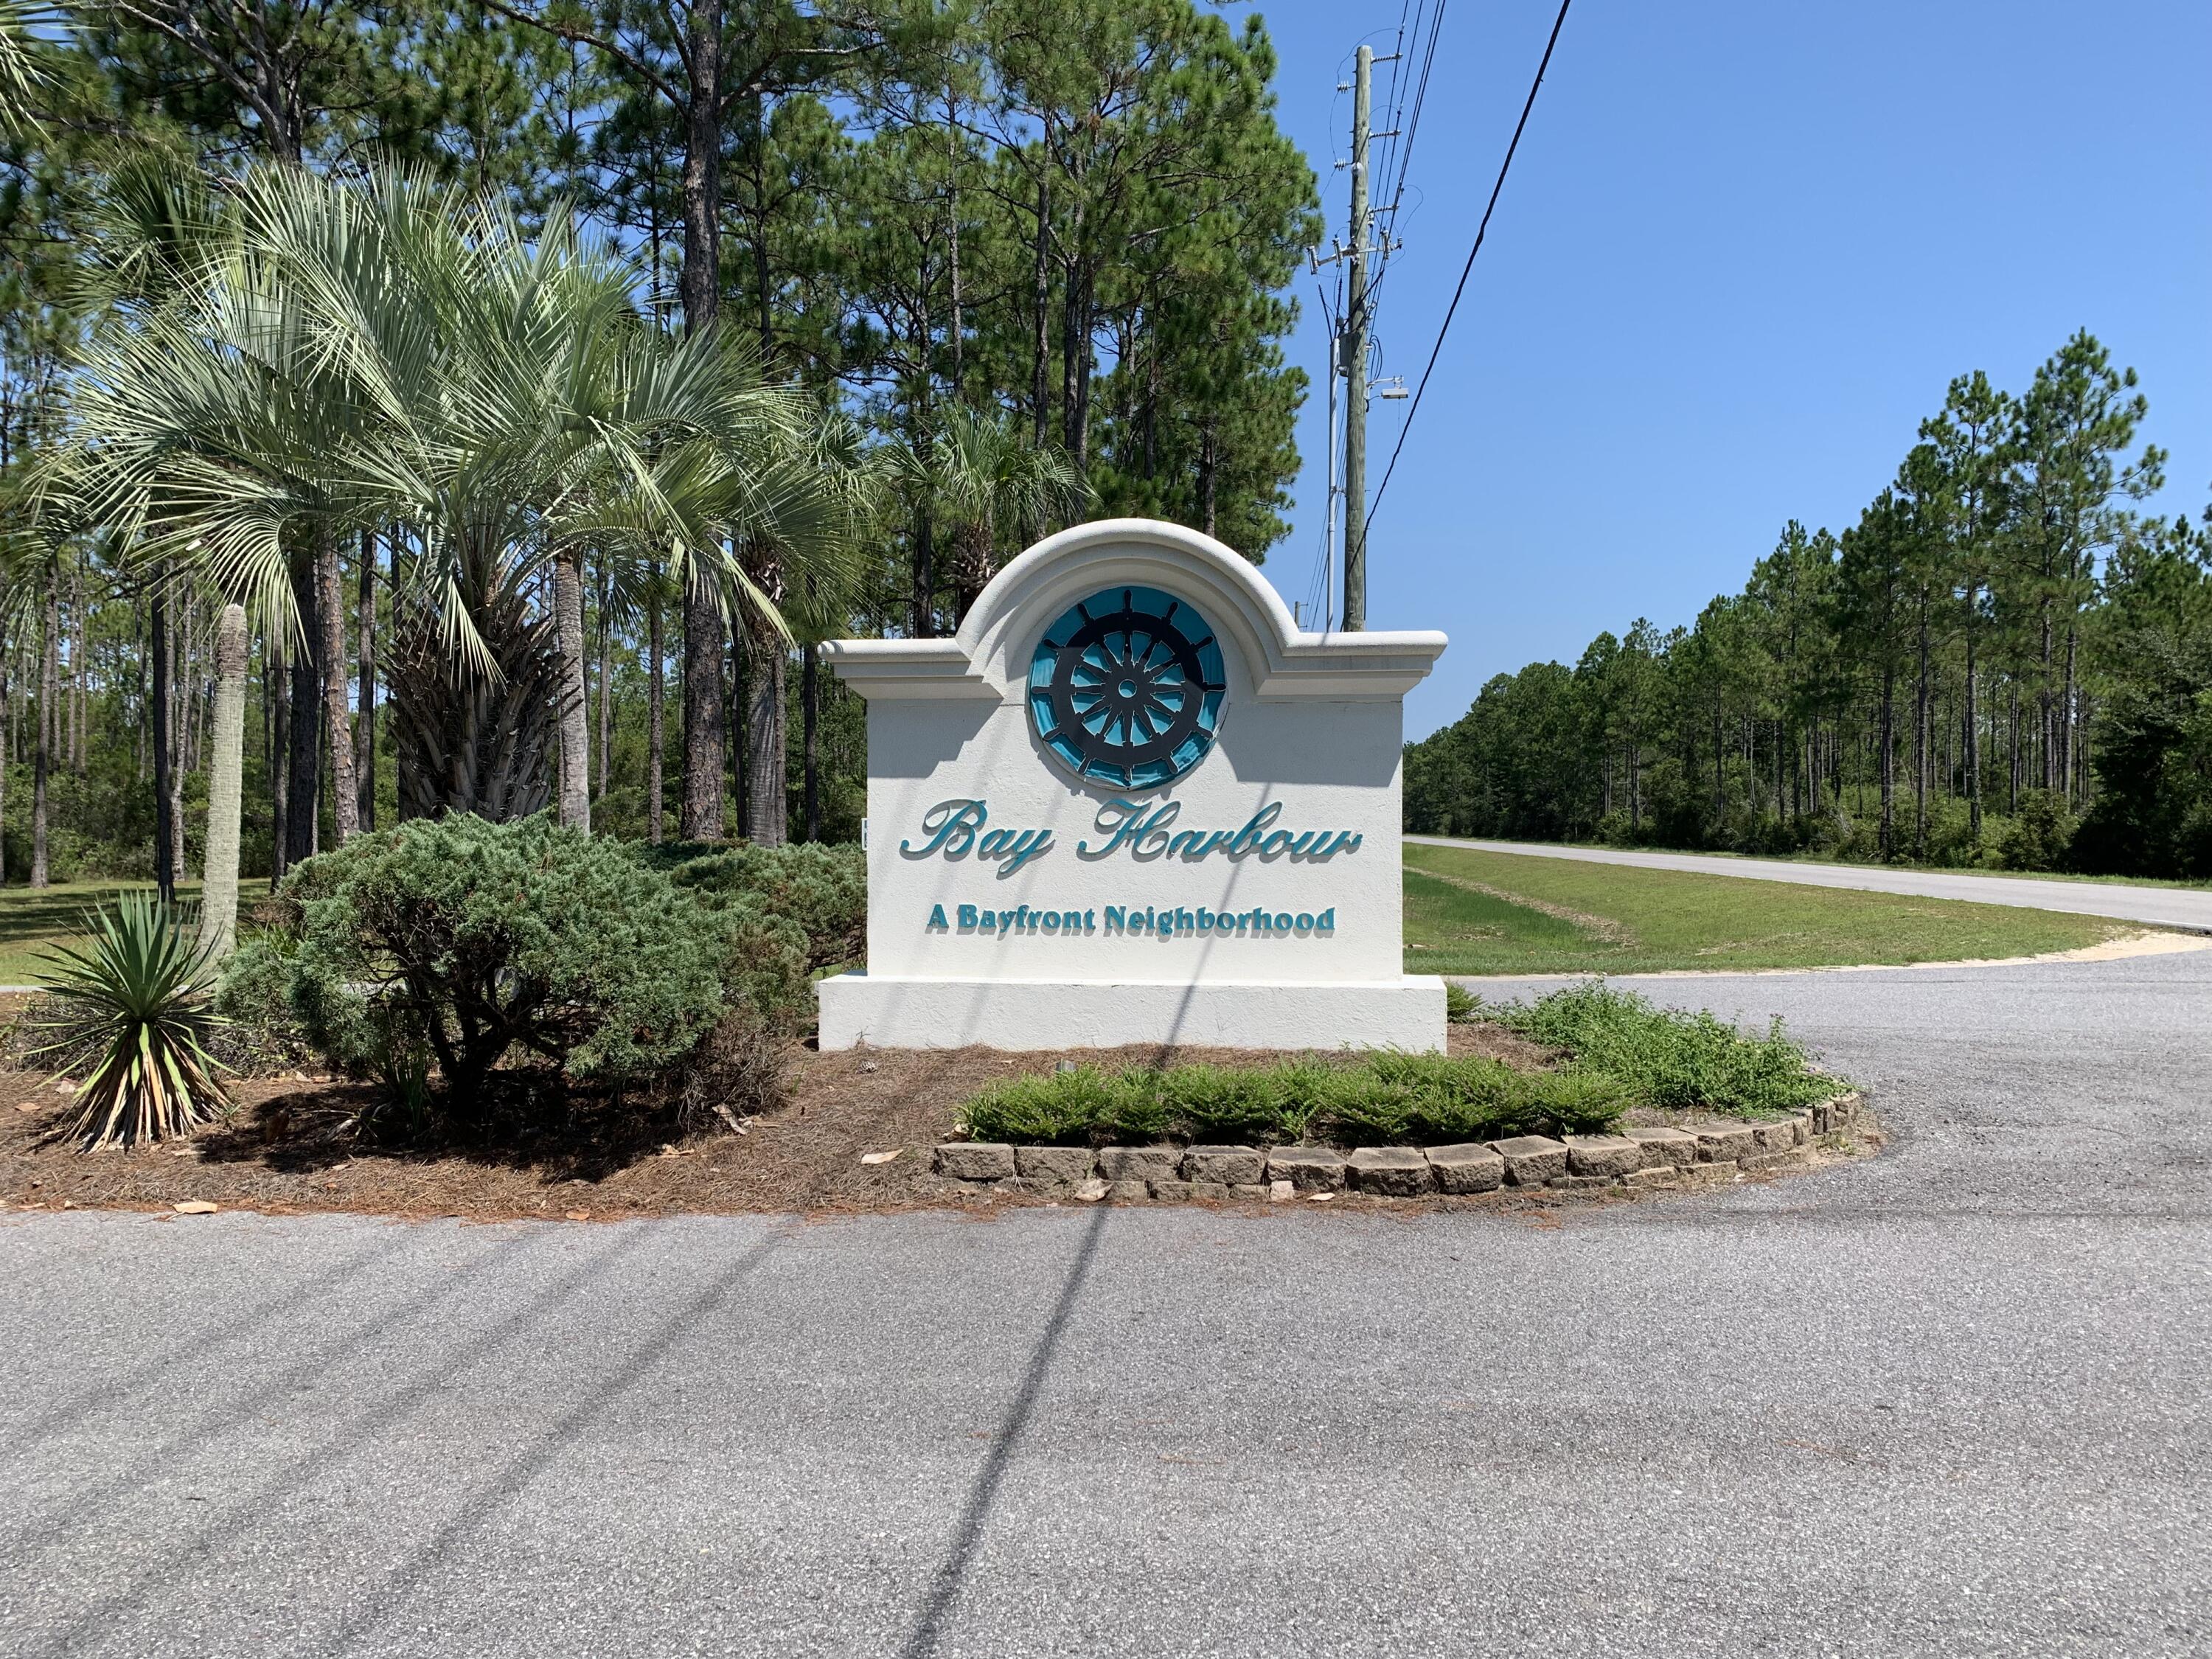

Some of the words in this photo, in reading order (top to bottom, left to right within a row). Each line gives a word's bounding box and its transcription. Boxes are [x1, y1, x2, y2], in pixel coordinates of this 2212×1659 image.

[900, 799, 1055, 872] Bay
[1077, 798, 1363, 858] Harbour
[927, 904, 949, 929] A
[958, 904, 1096, 935] Bayfront
[1105, 905, 1336, 936] Neighborhood
